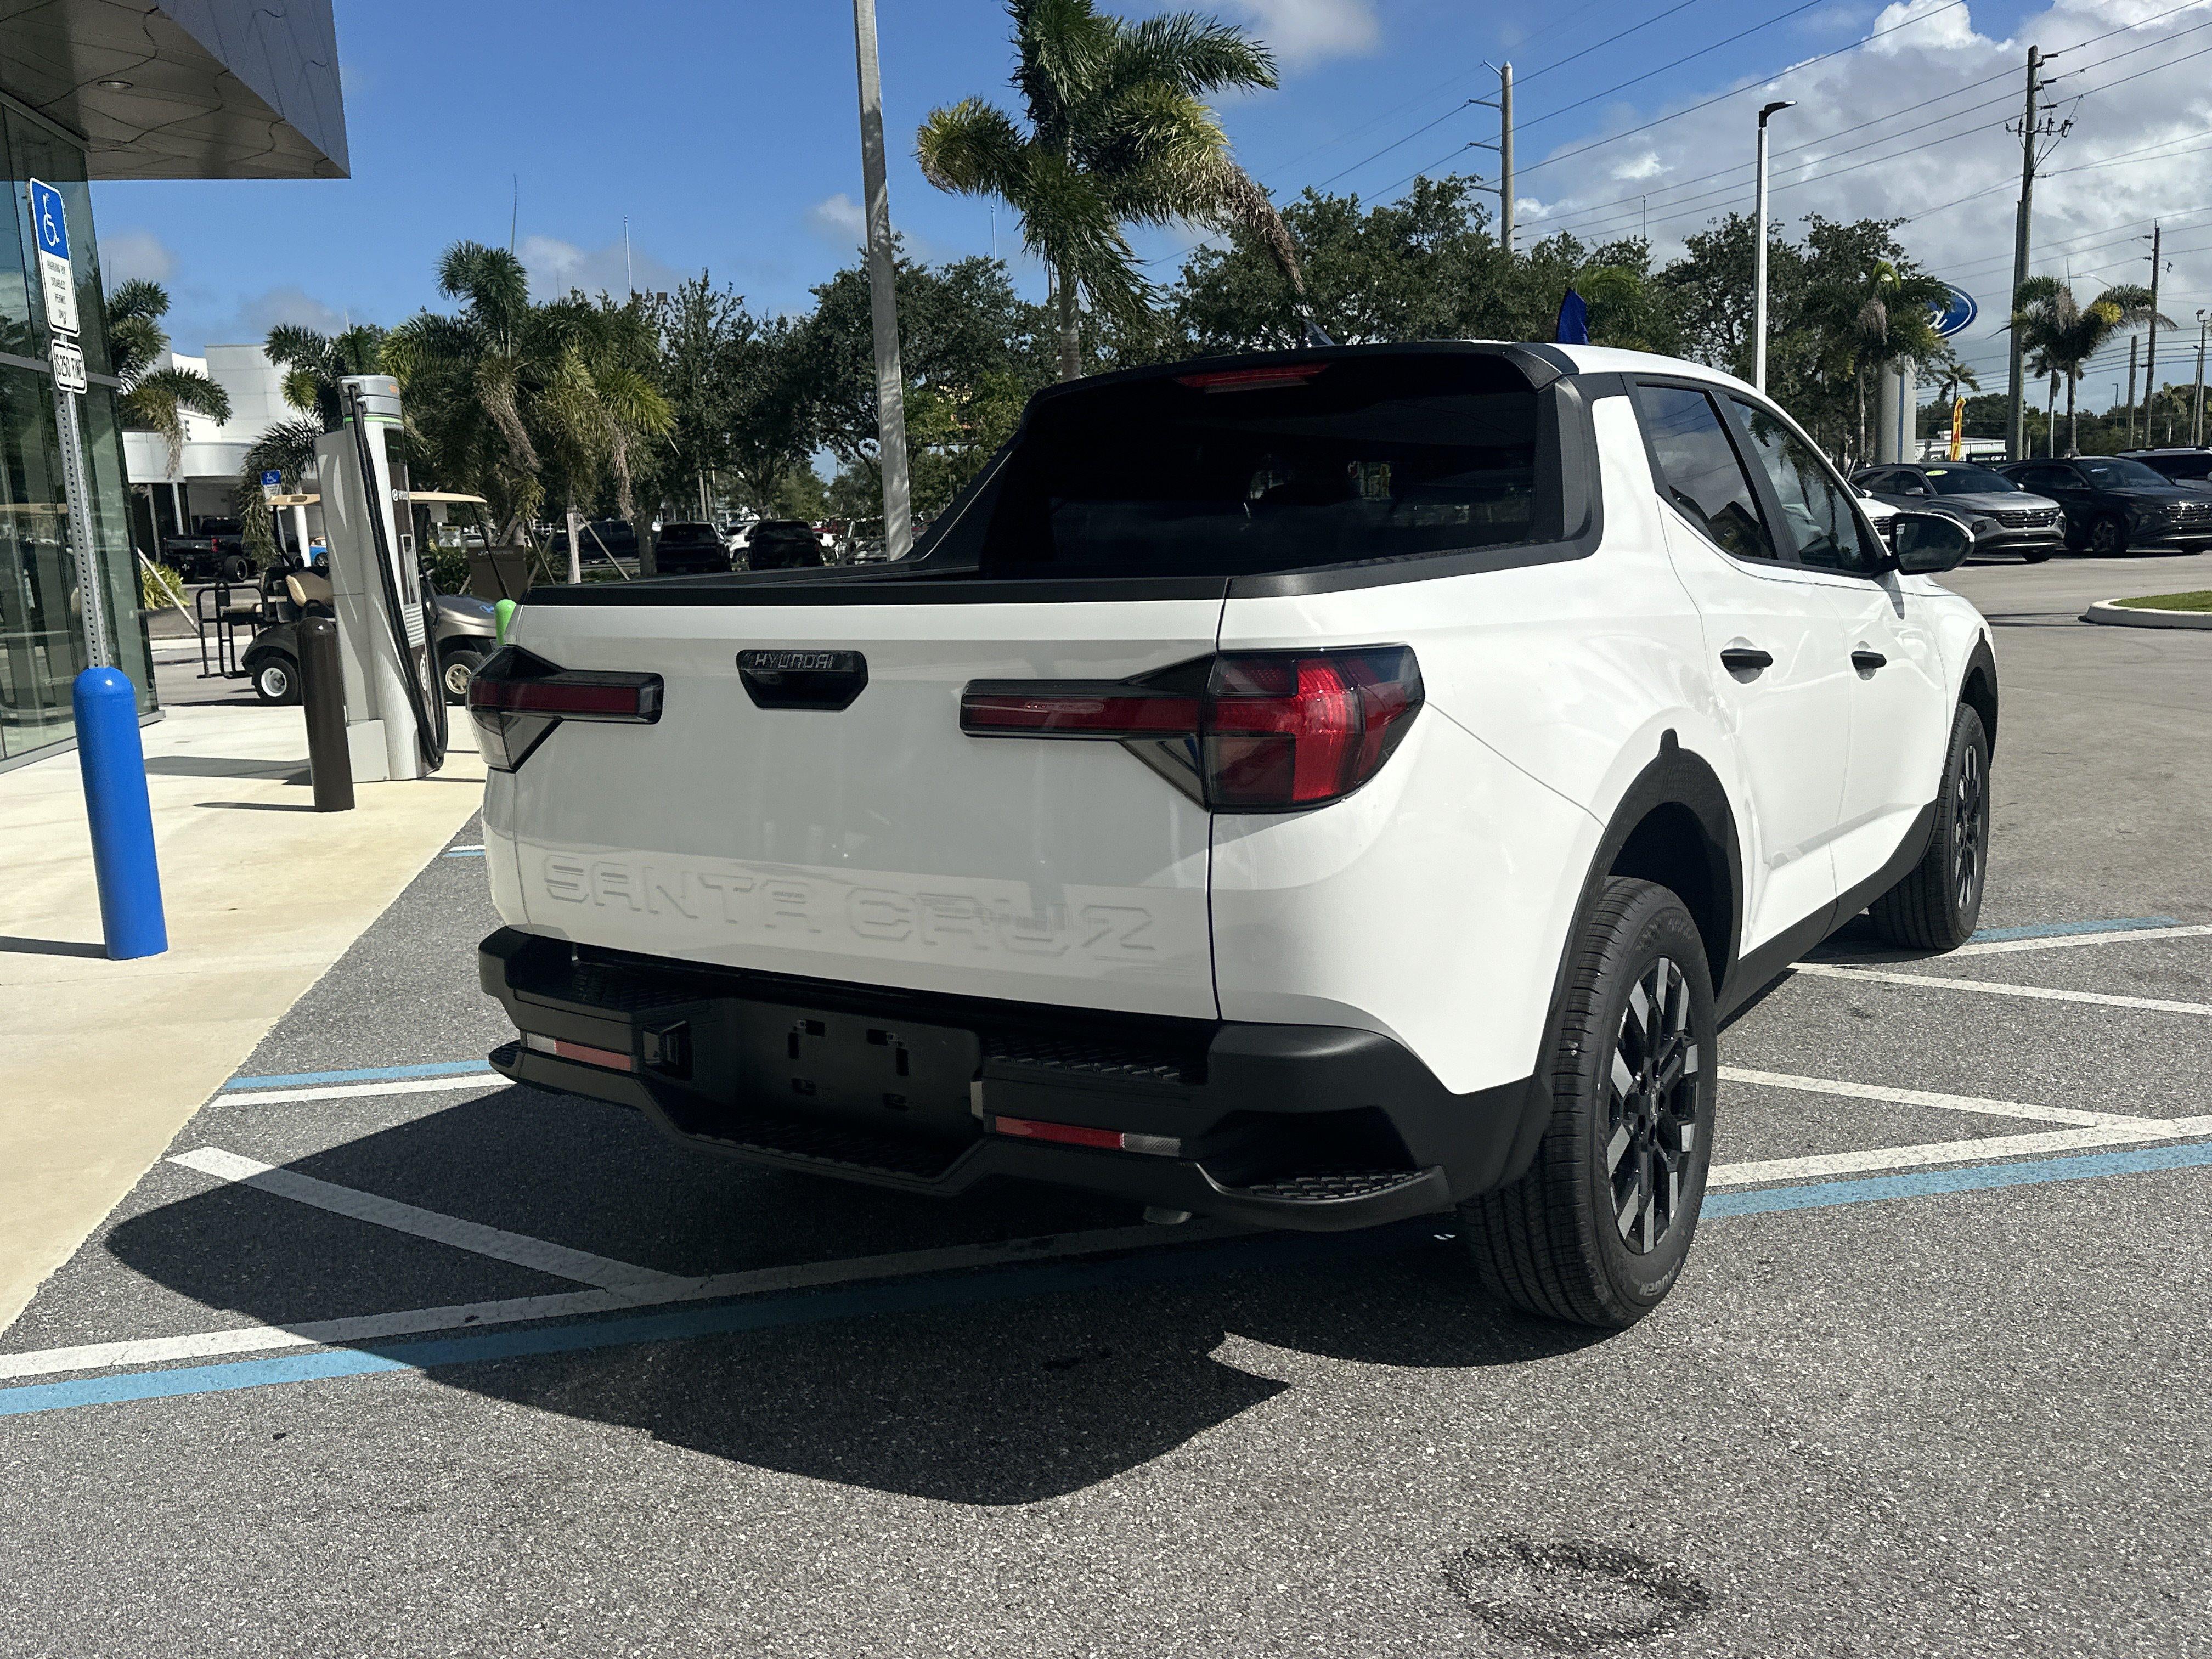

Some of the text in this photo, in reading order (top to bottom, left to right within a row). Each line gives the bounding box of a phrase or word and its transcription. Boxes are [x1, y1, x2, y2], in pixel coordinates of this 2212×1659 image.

[755, 653, 834, 669] HYUNDAI
[543, 854, 1156, 957] SANTA CRUZ
